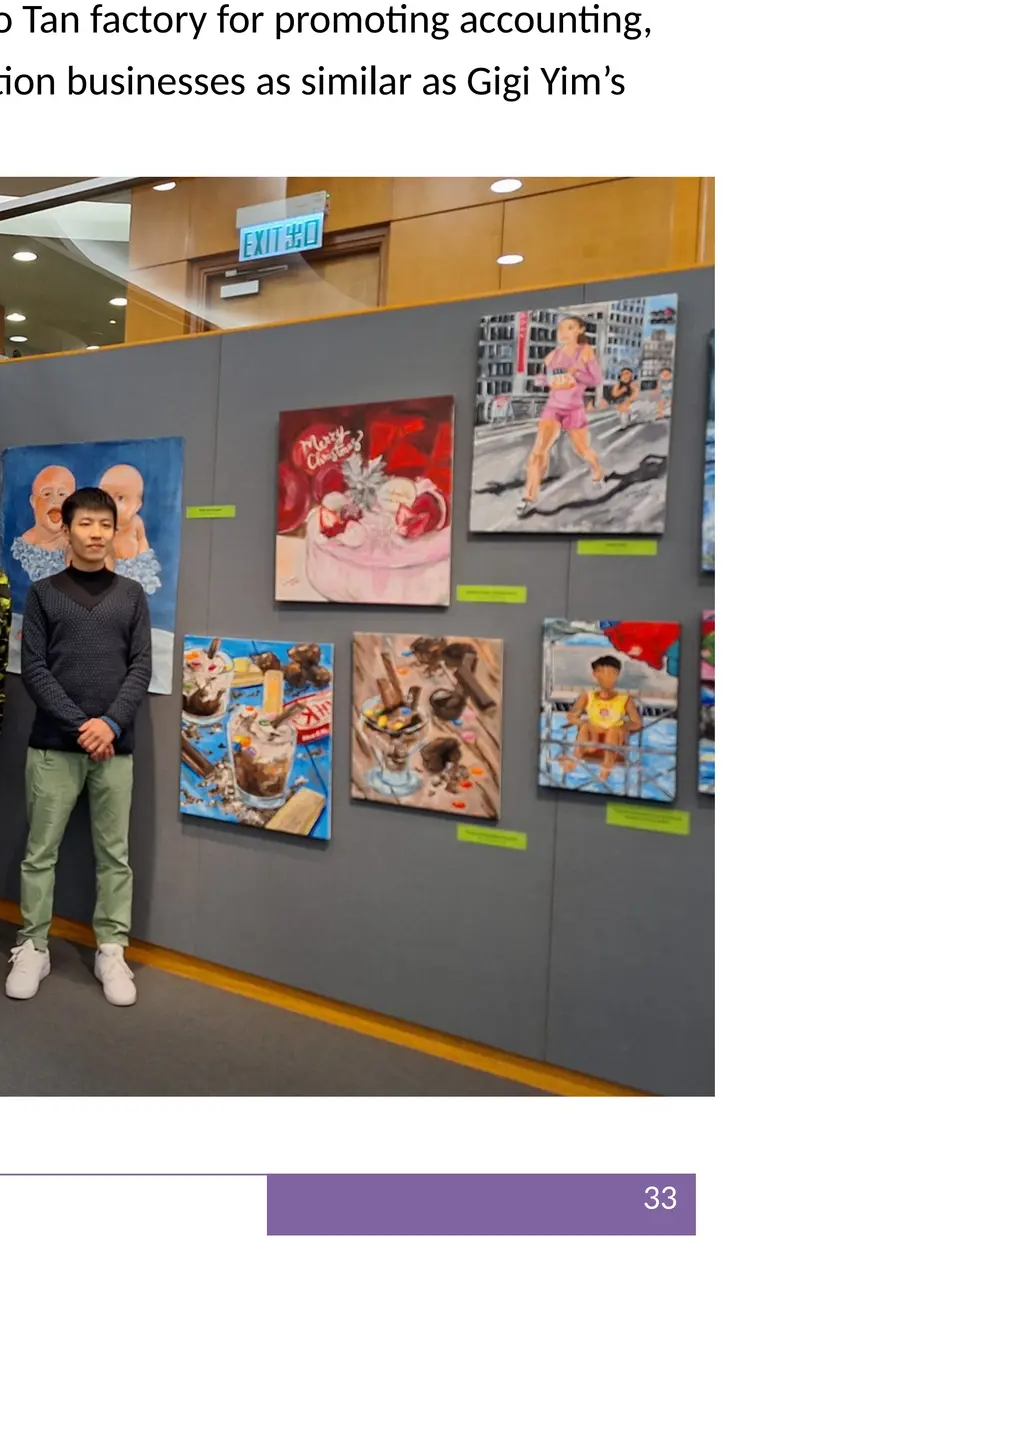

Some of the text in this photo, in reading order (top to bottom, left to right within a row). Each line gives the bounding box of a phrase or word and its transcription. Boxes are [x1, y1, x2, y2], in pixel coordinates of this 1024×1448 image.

[23, 6, 78, 33] Tan
[90, 4, 207, 39] factory
[217, 4, 264, 33] for
[277, 4, 449, 40] promoting
[461, 4, 650, 40] accounting,
[69, 66, 245, 95] businesses
[257, 74, 290, 95] as
[302, 65, 411, 95] similar
[423, 74, 456, 95] as
[468, 66, 529, 102] Gigi
[541, 66, 624, 95] Yim’s
[243, 219, 320, 258] EXIT 出口
[644, 1186, 677, 1210] 33
